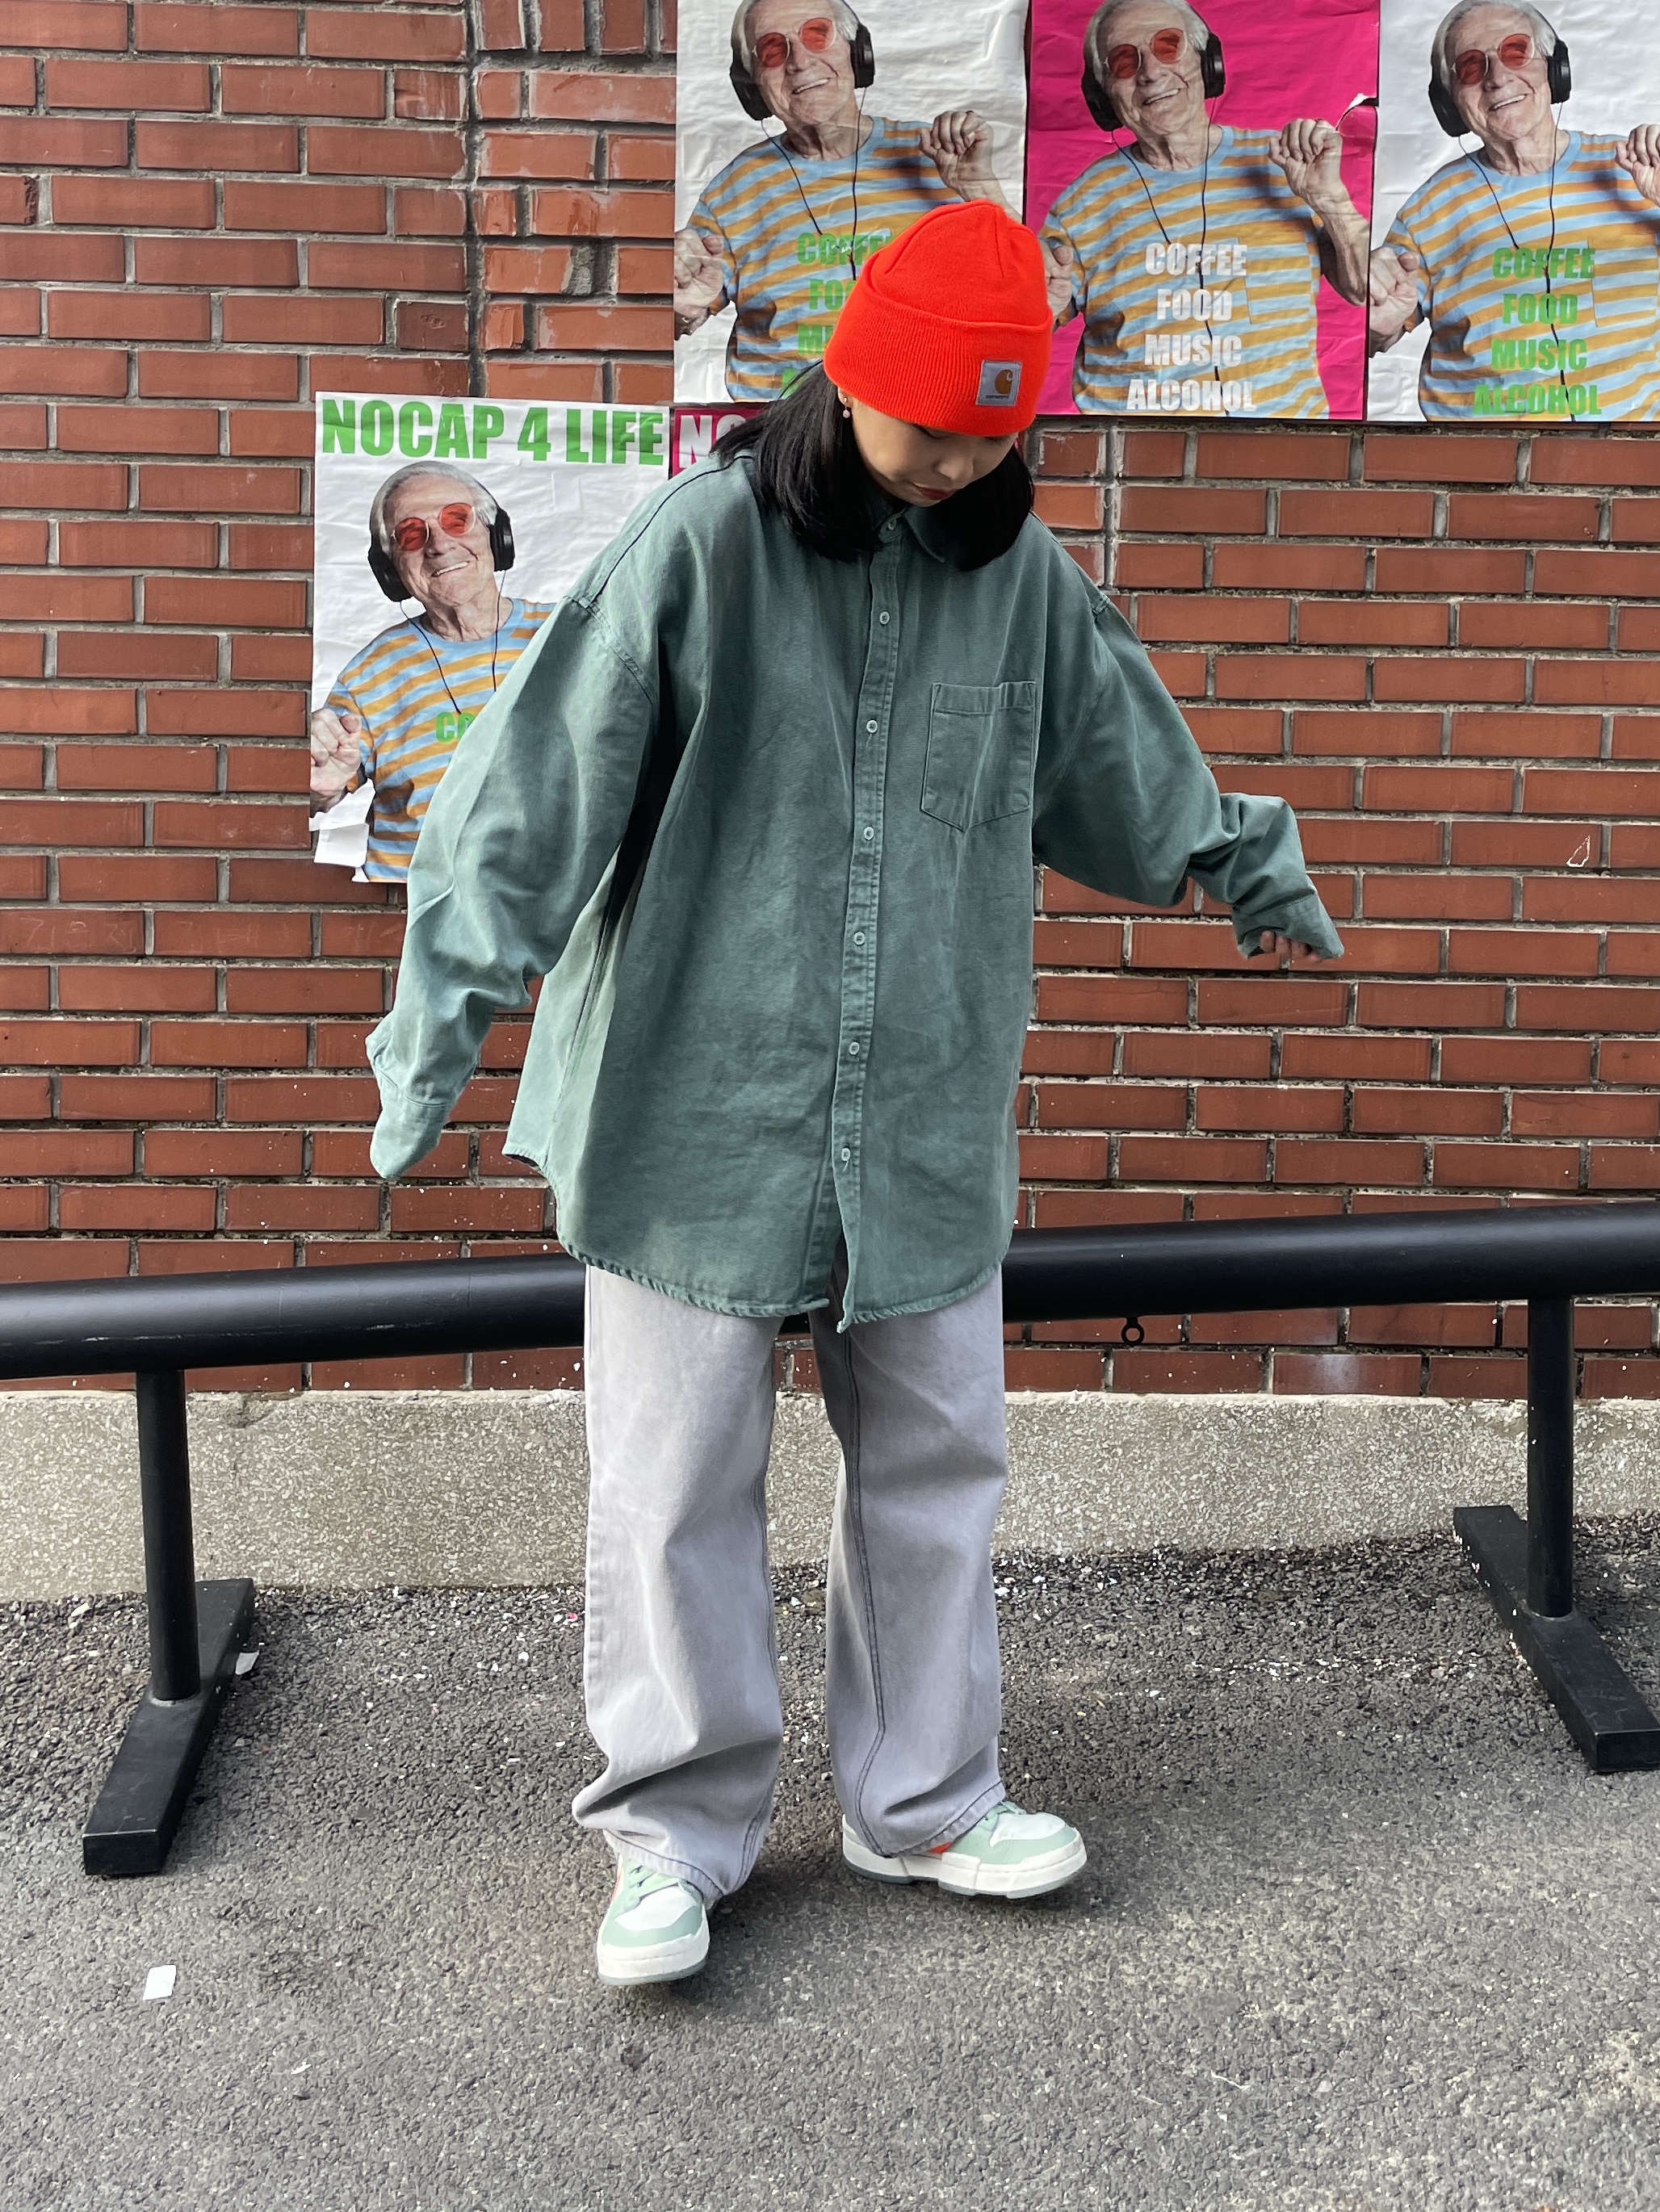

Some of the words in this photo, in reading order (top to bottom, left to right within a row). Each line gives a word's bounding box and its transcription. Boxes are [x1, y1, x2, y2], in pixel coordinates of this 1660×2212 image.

[1145, 242, 1248, 276] COFFEE
[1493, 247, 1596, 279] COFFEE
[1156, 288, 1233, 322] FOOD
[1502, 292, 1578, 325] FOOD
[1144, 333, 1243, 367] MUSIC
[1490, 338, 1589, 371] MUSIC
[1126, 378, 1257, 413] ALCOHOL
[1473, 383, 1603, 416] ALCOHOL
[321, 399, 505, 459] NOCAP
[517, 407, 551, 462] 4
[565, 408, 664, 466] LIFE
